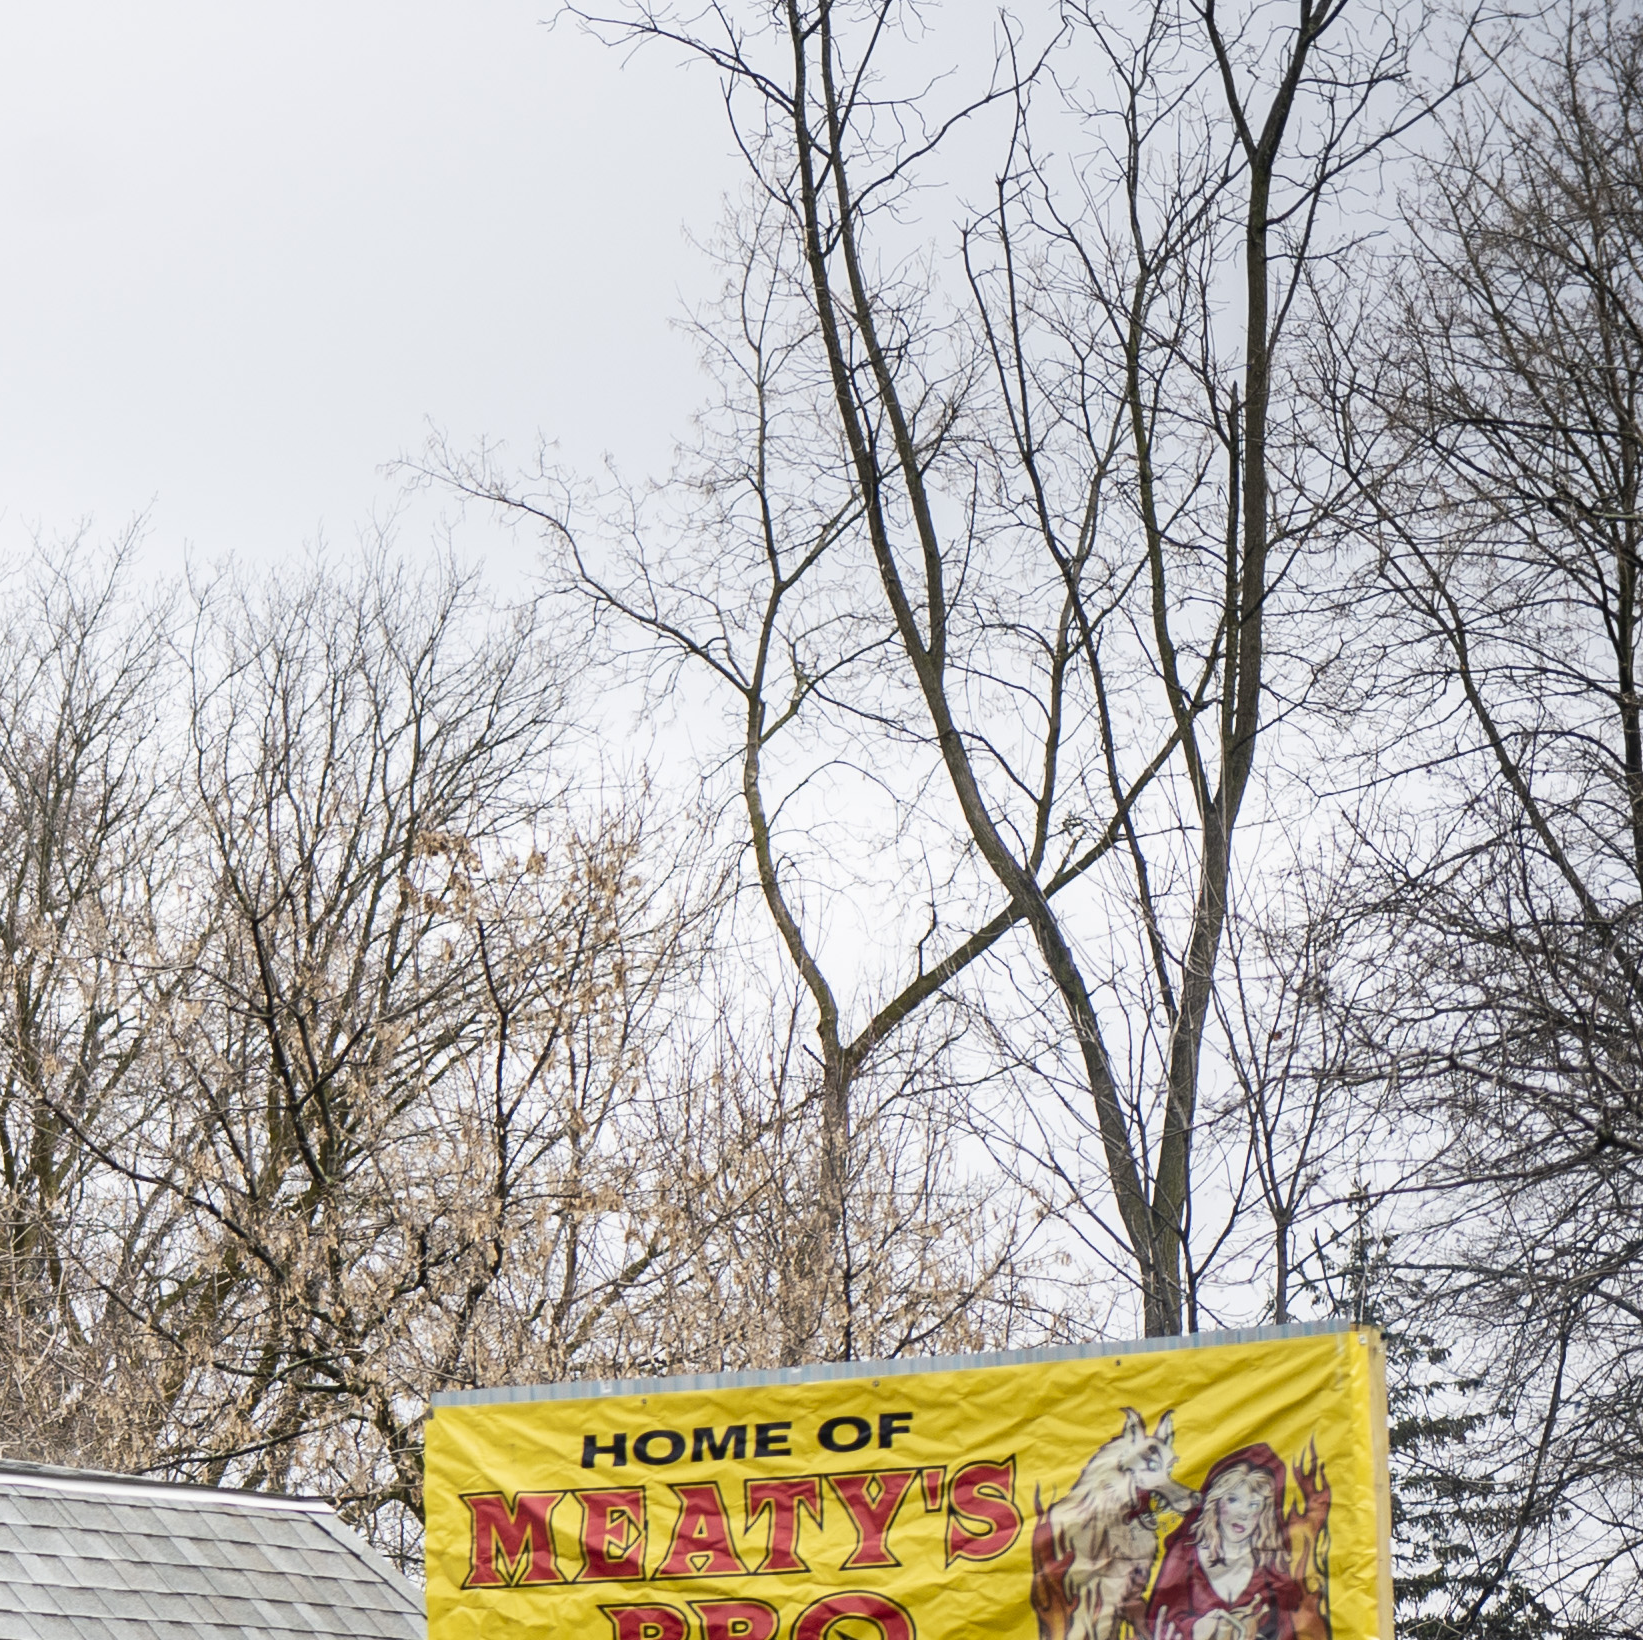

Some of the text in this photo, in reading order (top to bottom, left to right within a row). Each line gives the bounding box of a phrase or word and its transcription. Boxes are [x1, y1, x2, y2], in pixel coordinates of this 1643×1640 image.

[581, 1411, 914, 1470] HOME OF
[460, 1452, 1025, 1591] MEATY'S
